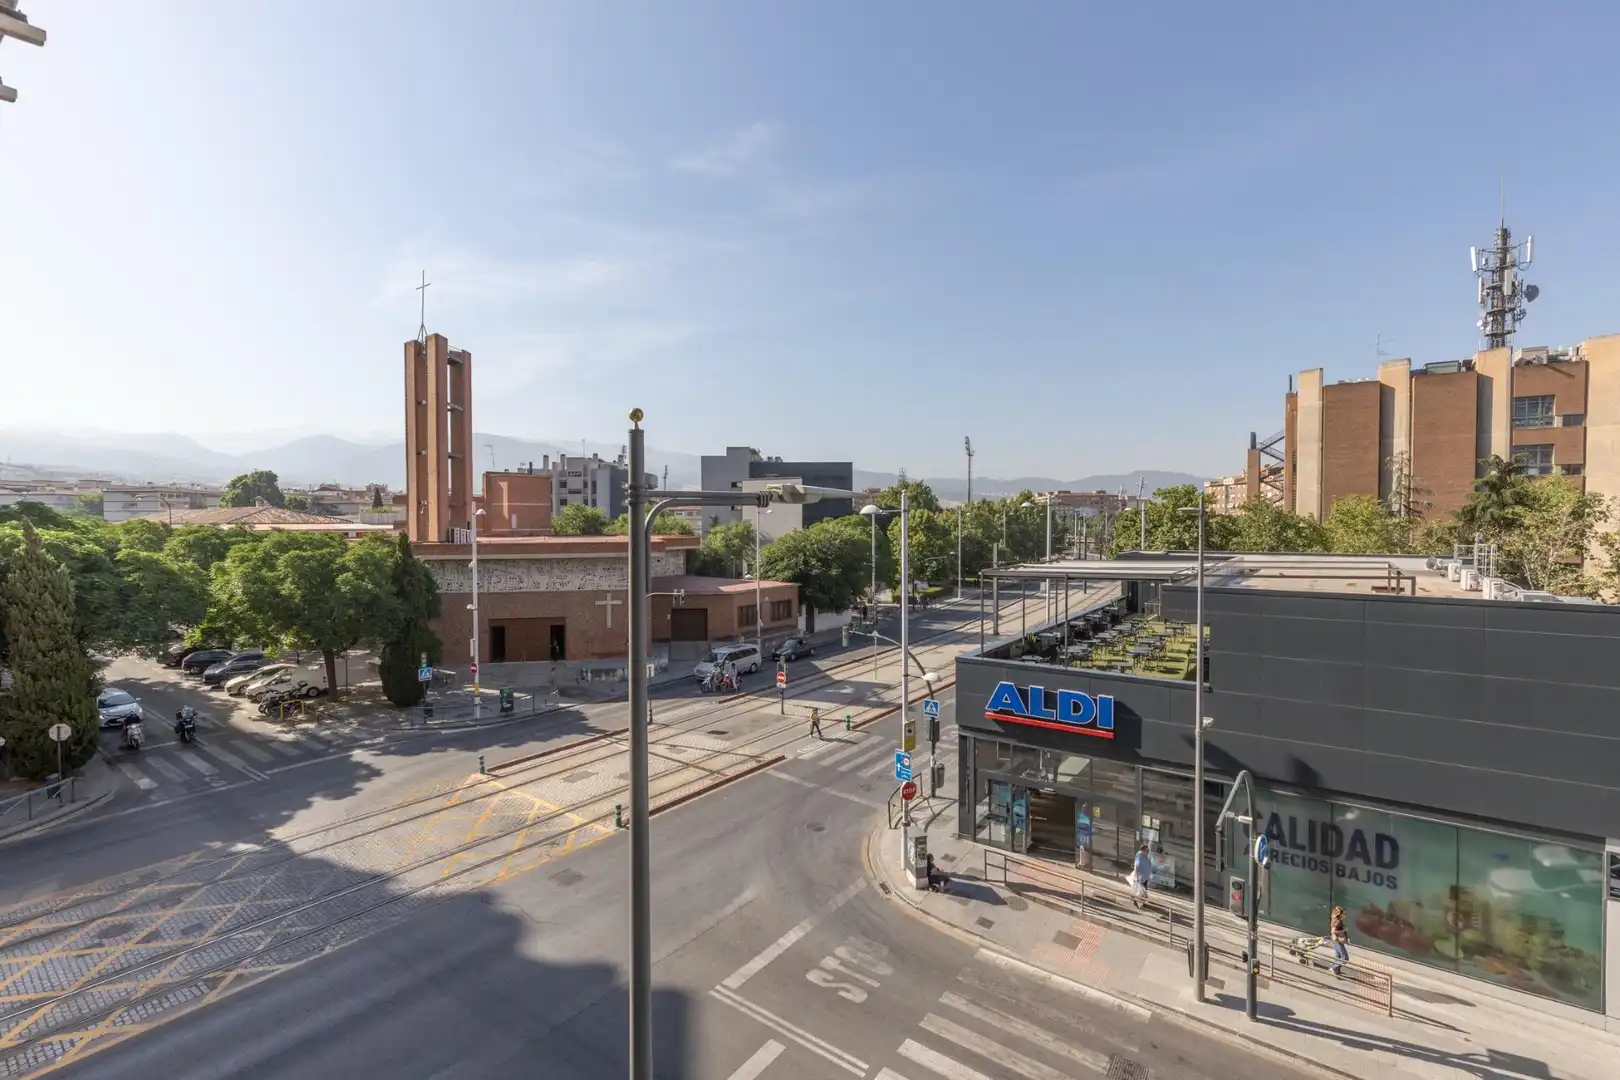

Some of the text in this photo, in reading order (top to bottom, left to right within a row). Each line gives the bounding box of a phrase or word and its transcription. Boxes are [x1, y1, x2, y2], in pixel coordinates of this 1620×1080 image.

[985, 681, 1114, 729] ALDI
[903, 787, 916, 795] STOP
[1268, 849, 1330, 874] RECIOS
[1336, 863, 1398, 890] BAJOS
